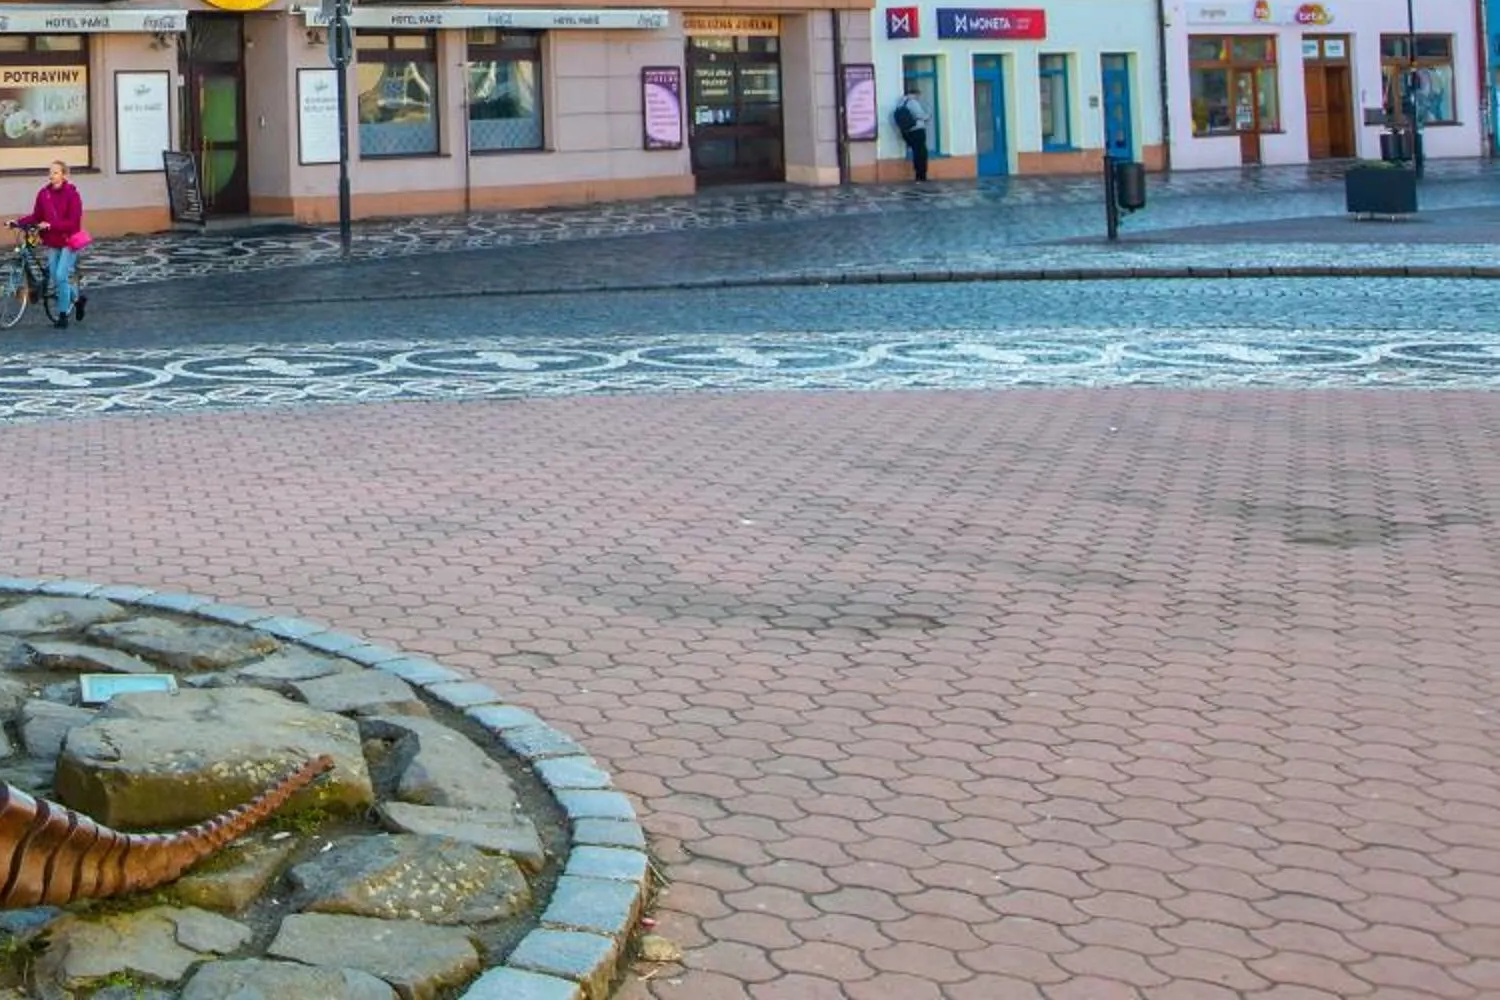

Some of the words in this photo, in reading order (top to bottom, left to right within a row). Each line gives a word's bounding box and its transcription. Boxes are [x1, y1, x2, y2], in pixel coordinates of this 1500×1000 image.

[45, 18, 78, 29] HOTEL
[969, 17, 1011, 30] MONETA
[3, 70, 79, 82] POTRAVINY
